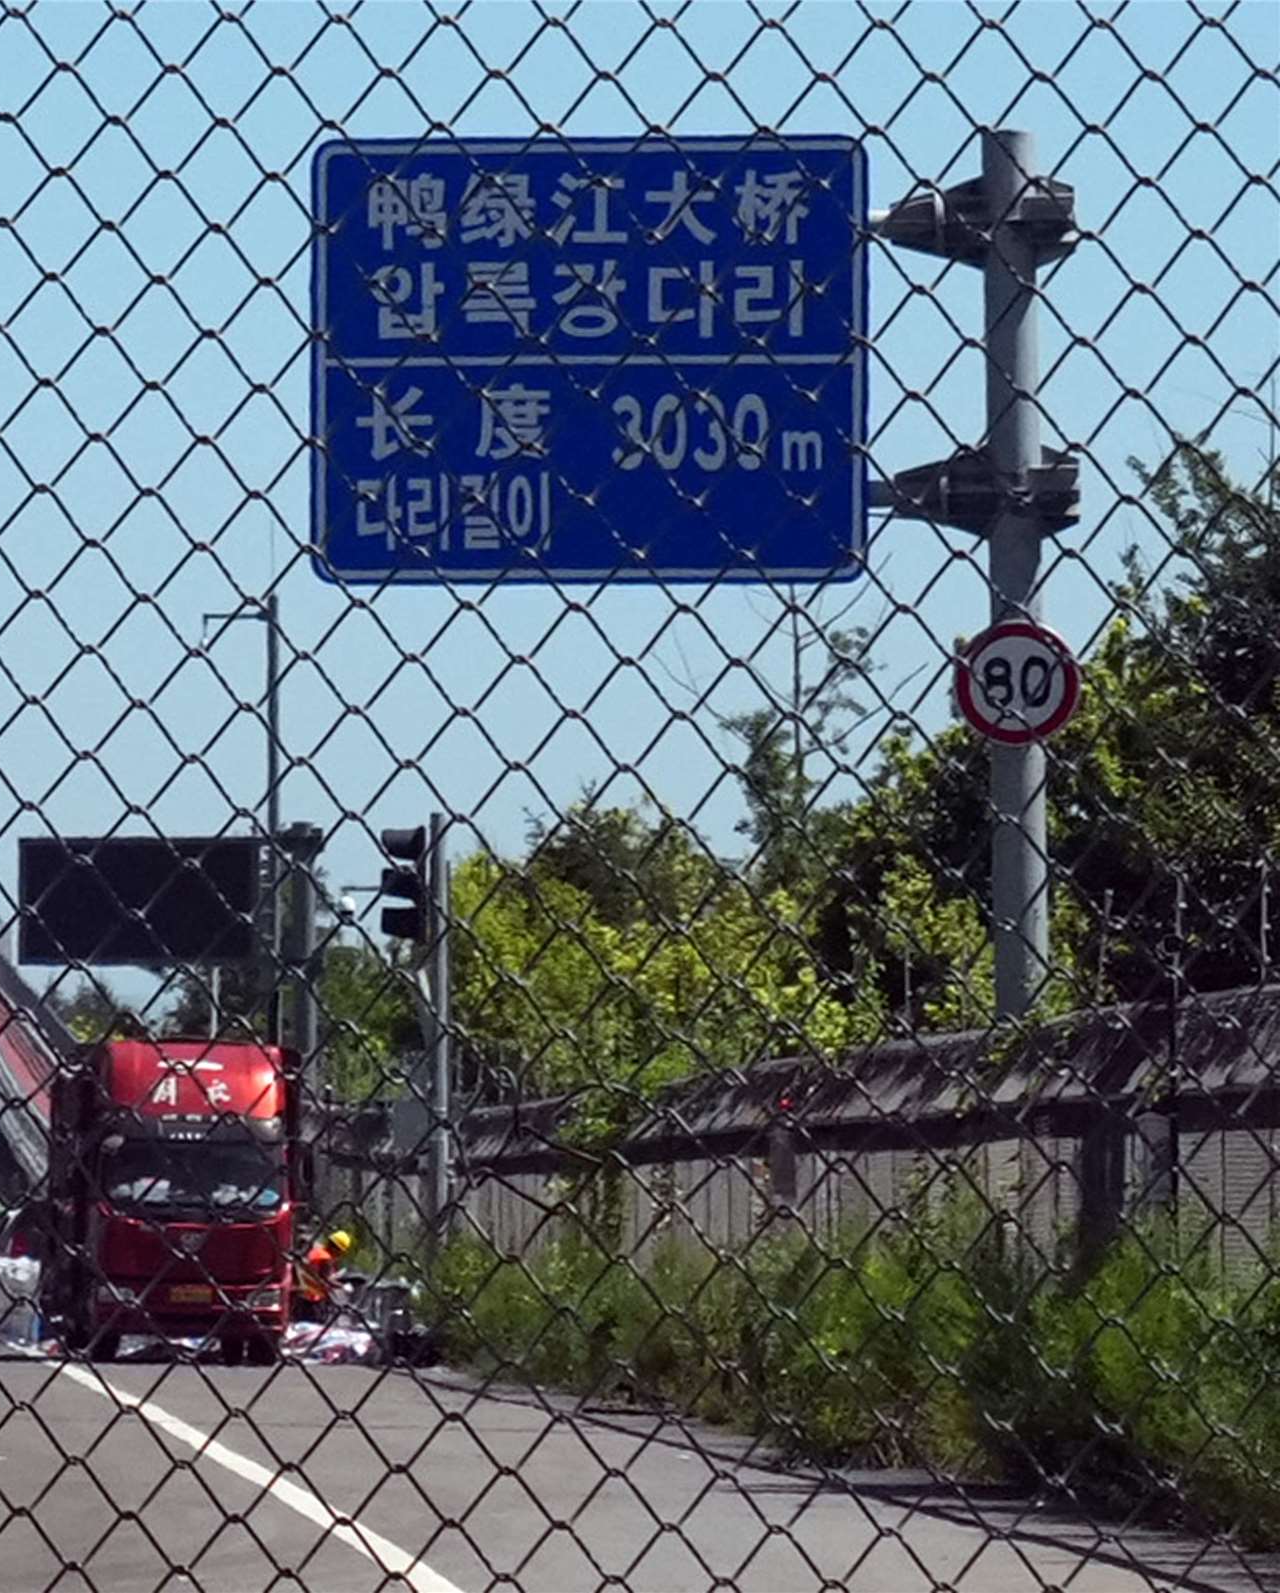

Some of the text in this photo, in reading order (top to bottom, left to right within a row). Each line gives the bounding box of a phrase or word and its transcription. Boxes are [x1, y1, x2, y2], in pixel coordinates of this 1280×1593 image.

[367, 169, 810, 250] 鸭绿江大桥
[370, 259, 805, 339] 압록강다리
[356, 471, 551, 551] 다리길이
[983, 656, 1052, 708] 80
